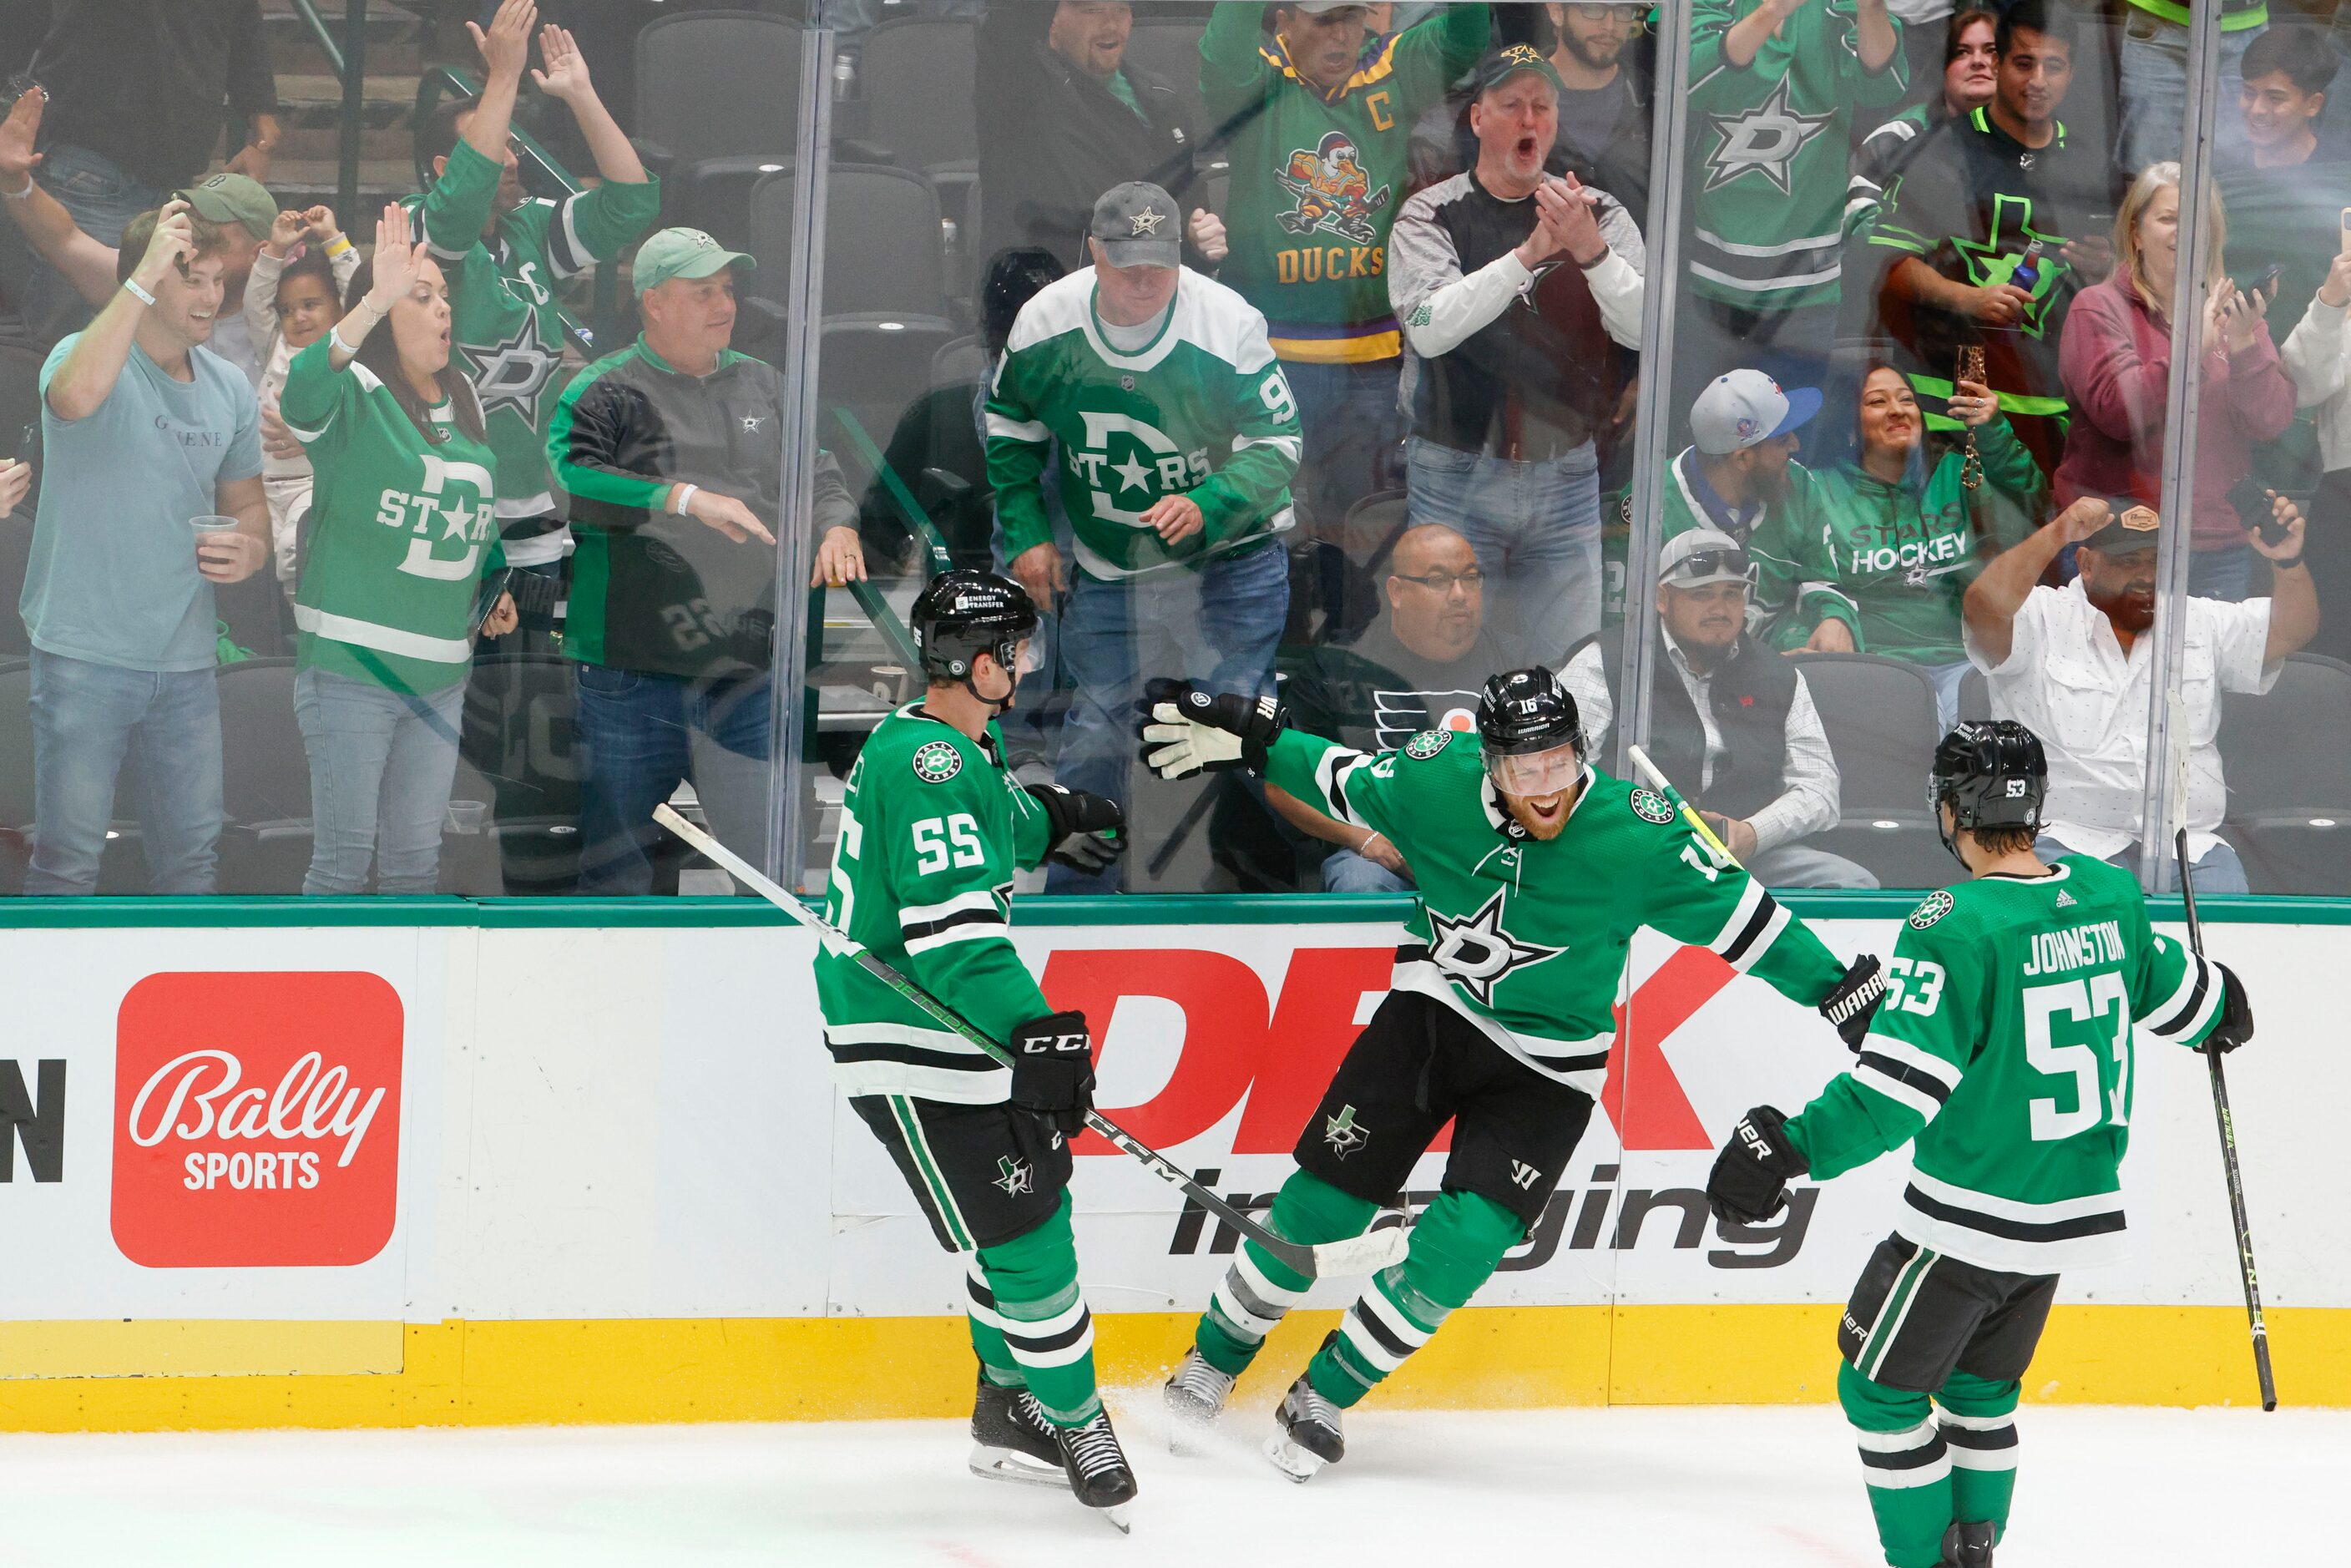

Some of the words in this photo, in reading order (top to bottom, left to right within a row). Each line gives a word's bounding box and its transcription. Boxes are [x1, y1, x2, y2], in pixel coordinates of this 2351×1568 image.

[1366, 91, 1395, 132] C
[1277, 246, 1384, 284] DUCKS
[1259, 372, 1299, 425] 9
[1849, 502, 1963, 548] STARS
[1852, 530, 1966, 574] HOCKEY
[1519, 697, 1538, 715] 16
[1518, 722, 1550, 735] WARRIOR
[917, 742, 959, 761] DALLAS
[918, 767, 957, 781] STARS
[2005, 779, 2026, 798] 53
[912, 812, 985, 877] 55
[2023, 920, 2126, 976] JOHNSTON
[2022, 969, 2129, 1141] 53
[129, 1049, 387, 1168] Bally
[183, 1151, 320, 1191] SPORTS
